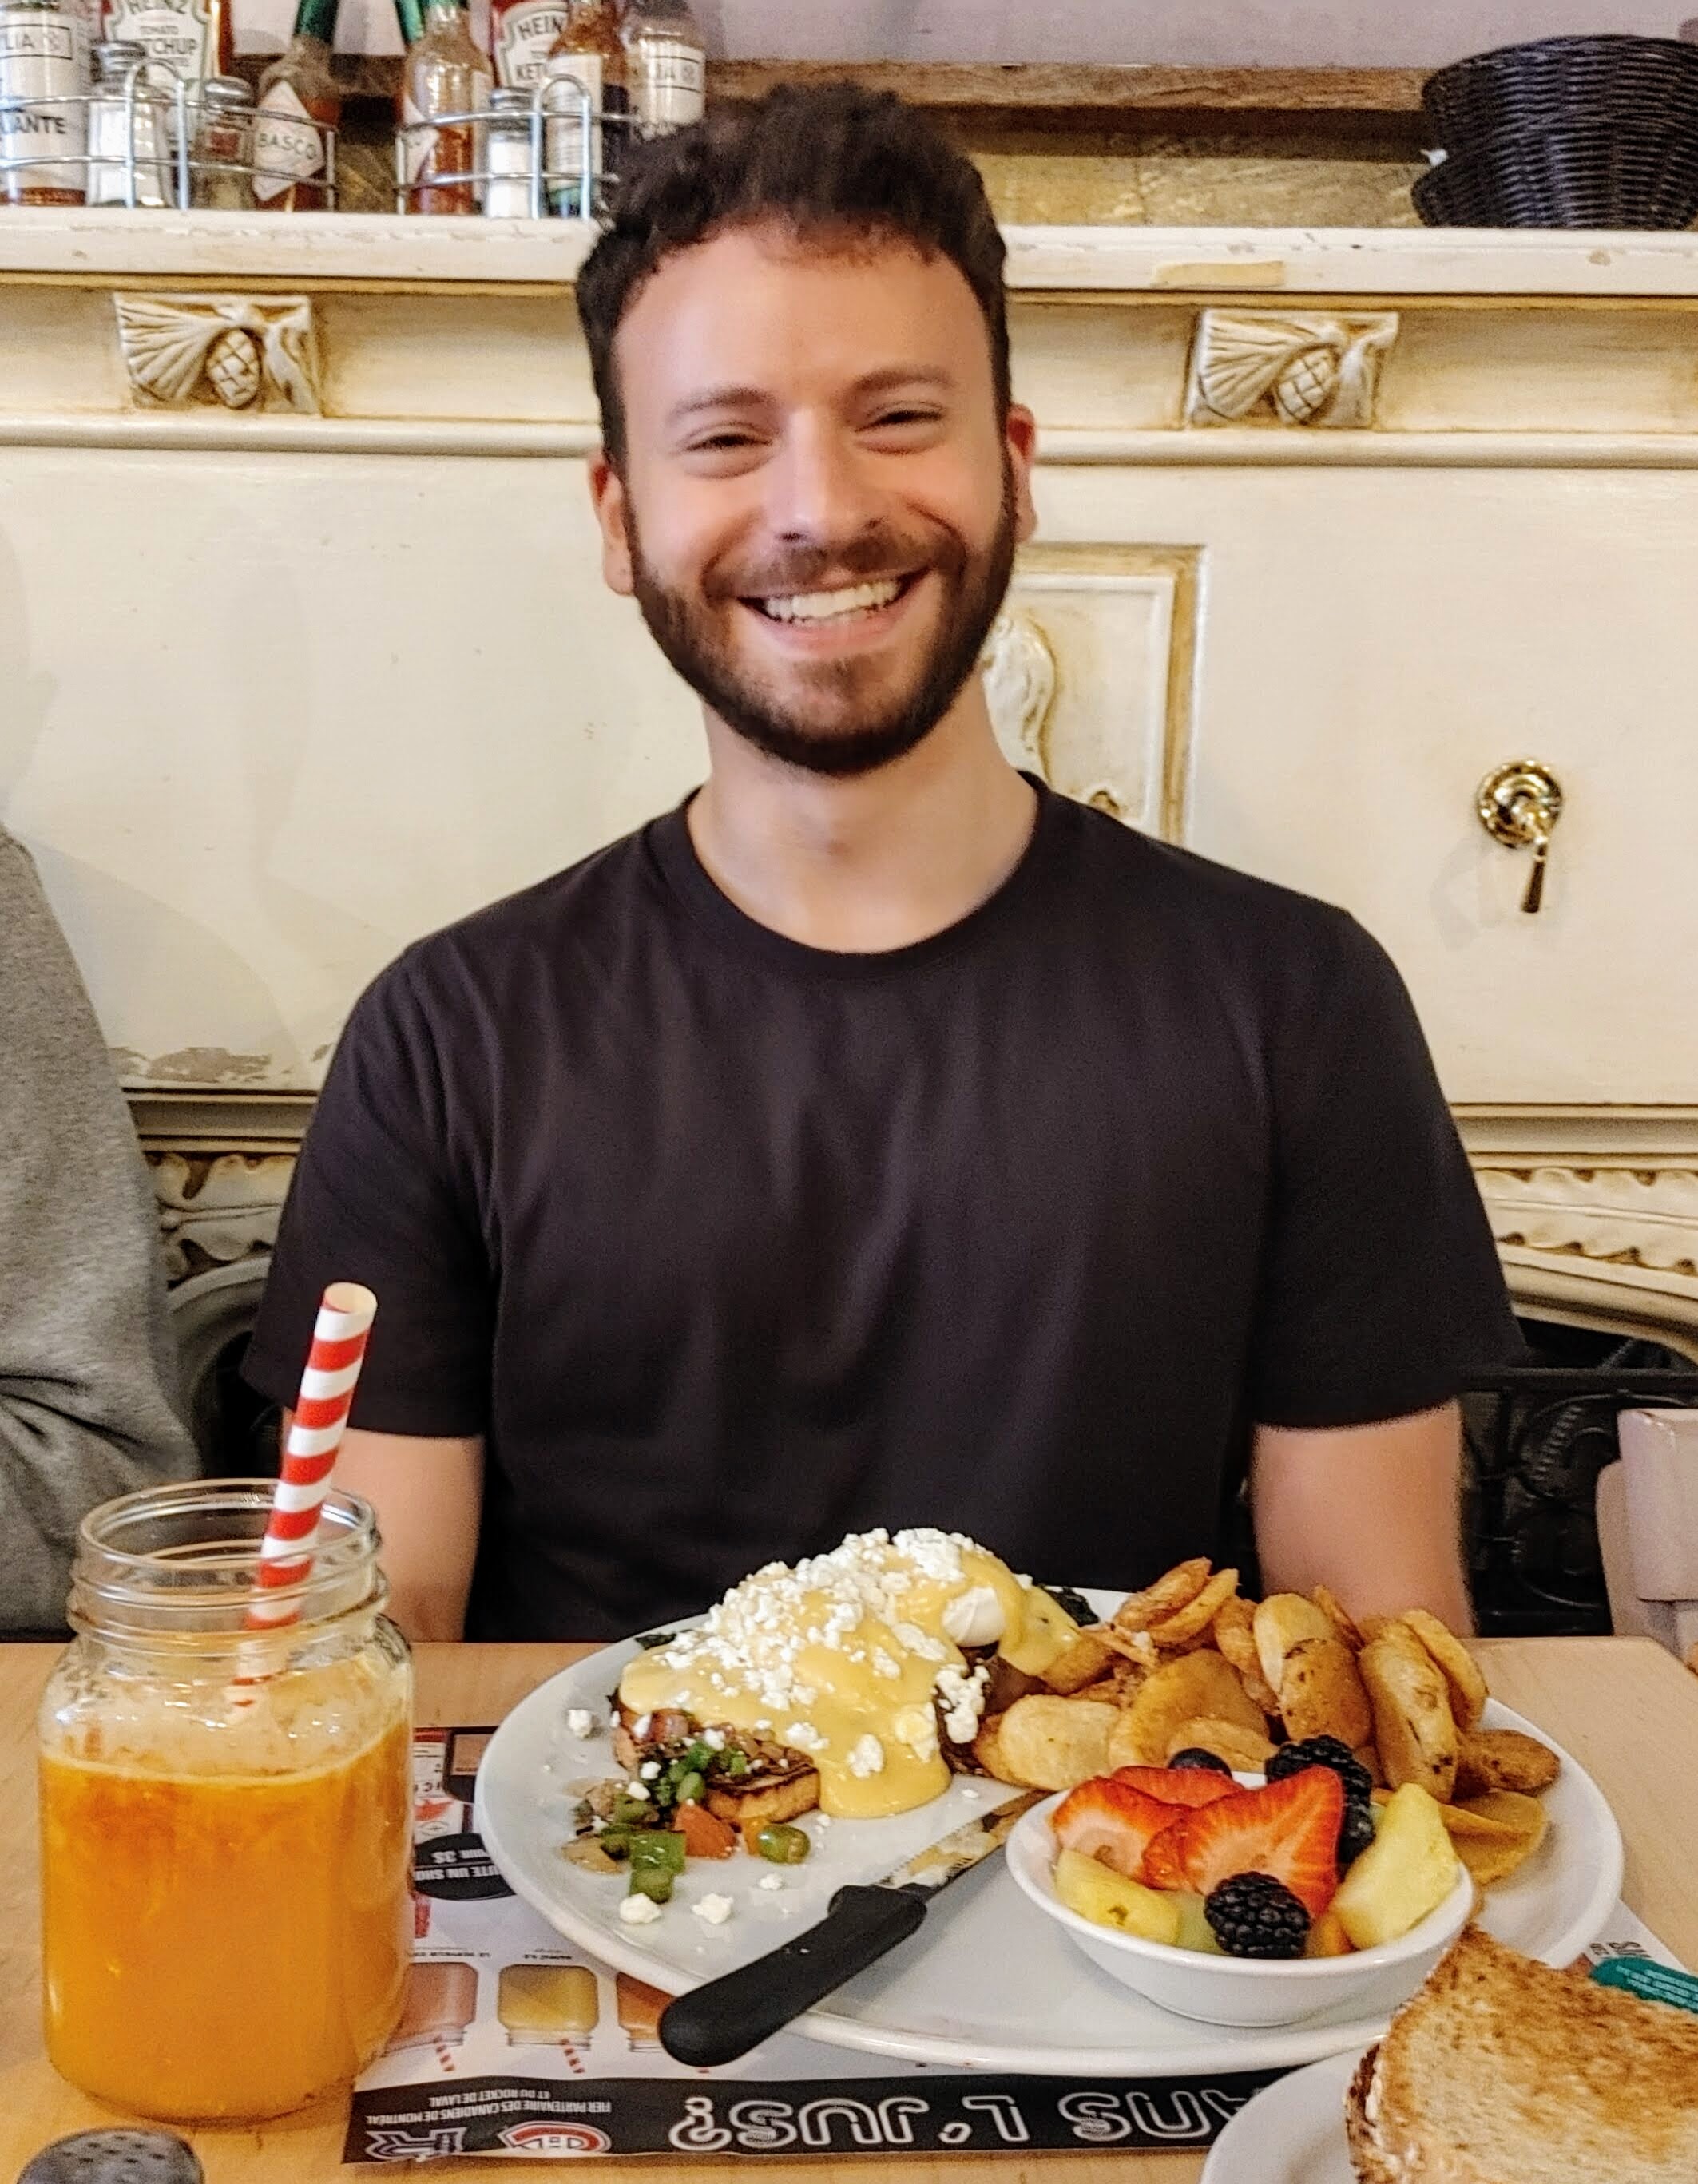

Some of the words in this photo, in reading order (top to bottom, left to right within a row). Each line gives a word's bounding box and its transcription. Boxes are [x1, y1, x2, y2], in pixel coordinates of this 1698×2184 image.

[517, 14, 562, 40] HEIN
[257, 132, 318, 160] BASCO
[428, 2092, 461, 2107] LAVAL
[462, 2091, 477, 2104] DE
[478, 2088, 518, 2102] ROCKET
[440, 2102, 499, 2122] CANADIENS
[500, 2101, 521, 2113] DES
[522, 2100, 587, 2113] PARTENAIRE
[588, 2100, 613, 2113] FIER
[364, 2111, 423, 2126] MONTRÉAL
[424, 2110, 438, 2122] DE
